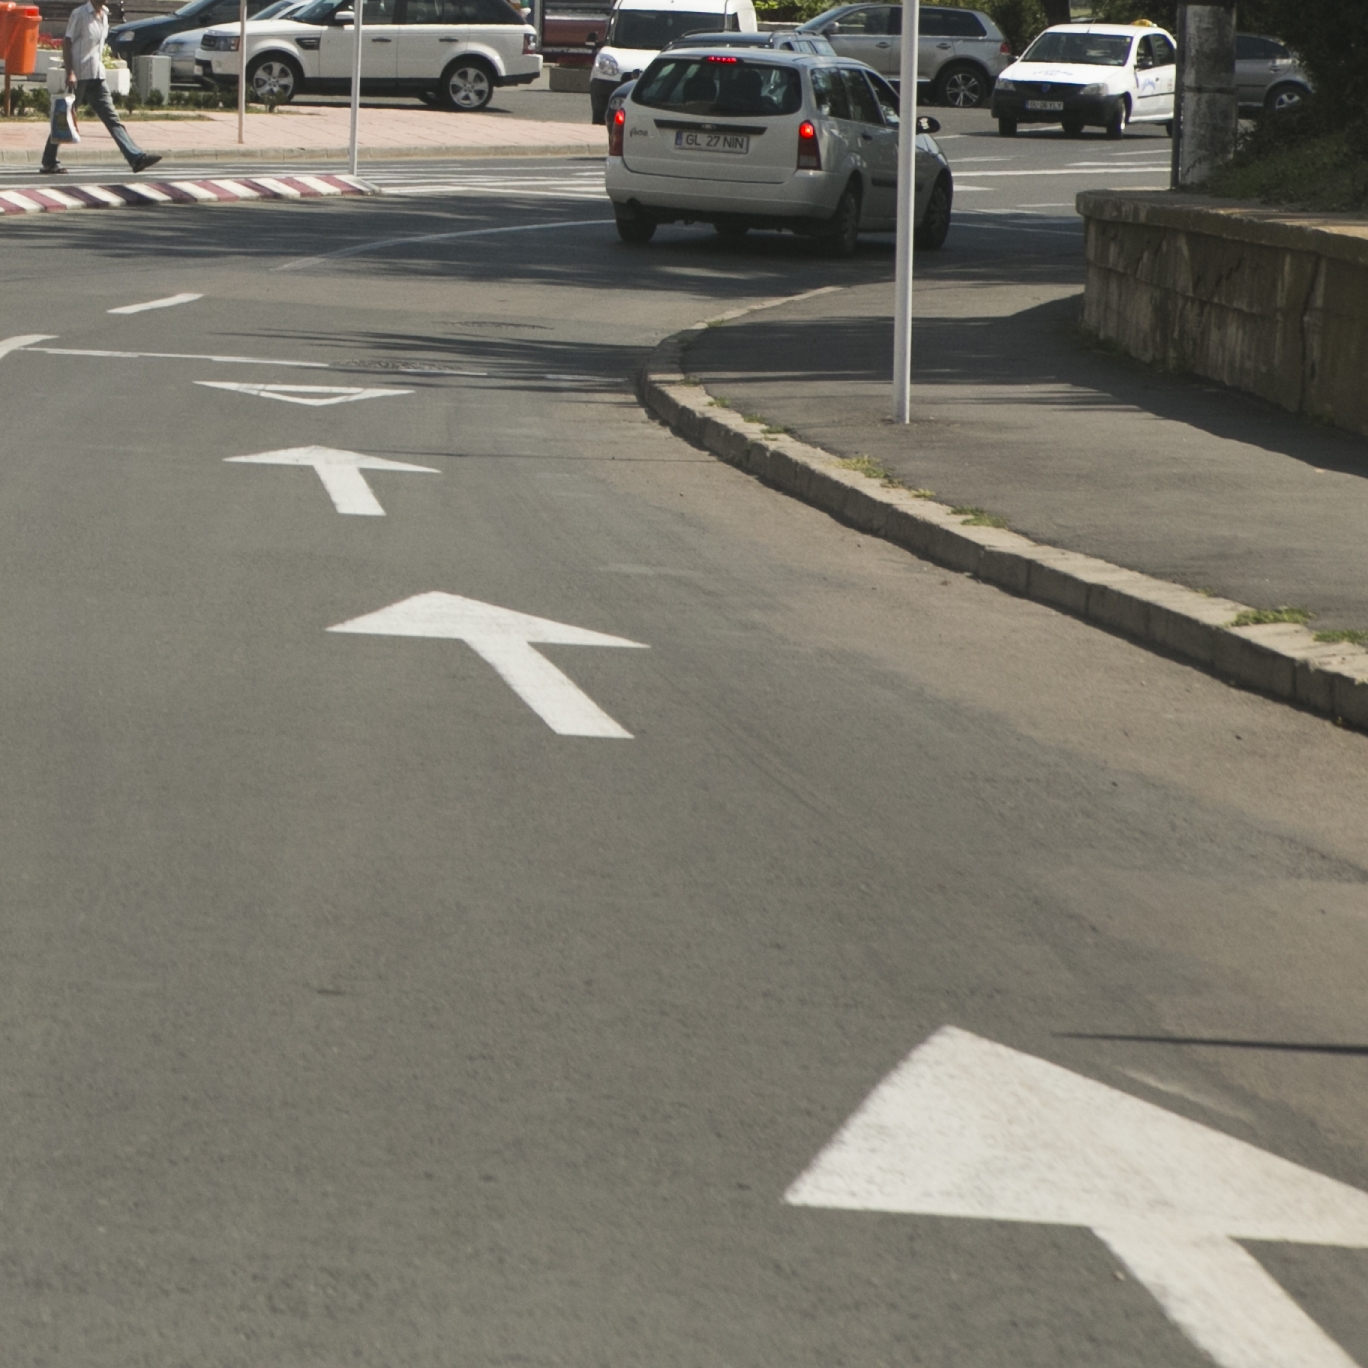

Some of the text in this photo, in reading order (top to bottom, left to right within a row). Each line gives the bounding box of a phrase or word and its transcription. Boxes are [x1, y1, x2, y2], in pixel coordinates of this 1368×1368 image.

[685, 134, 744, 149] GL 27 NIN
